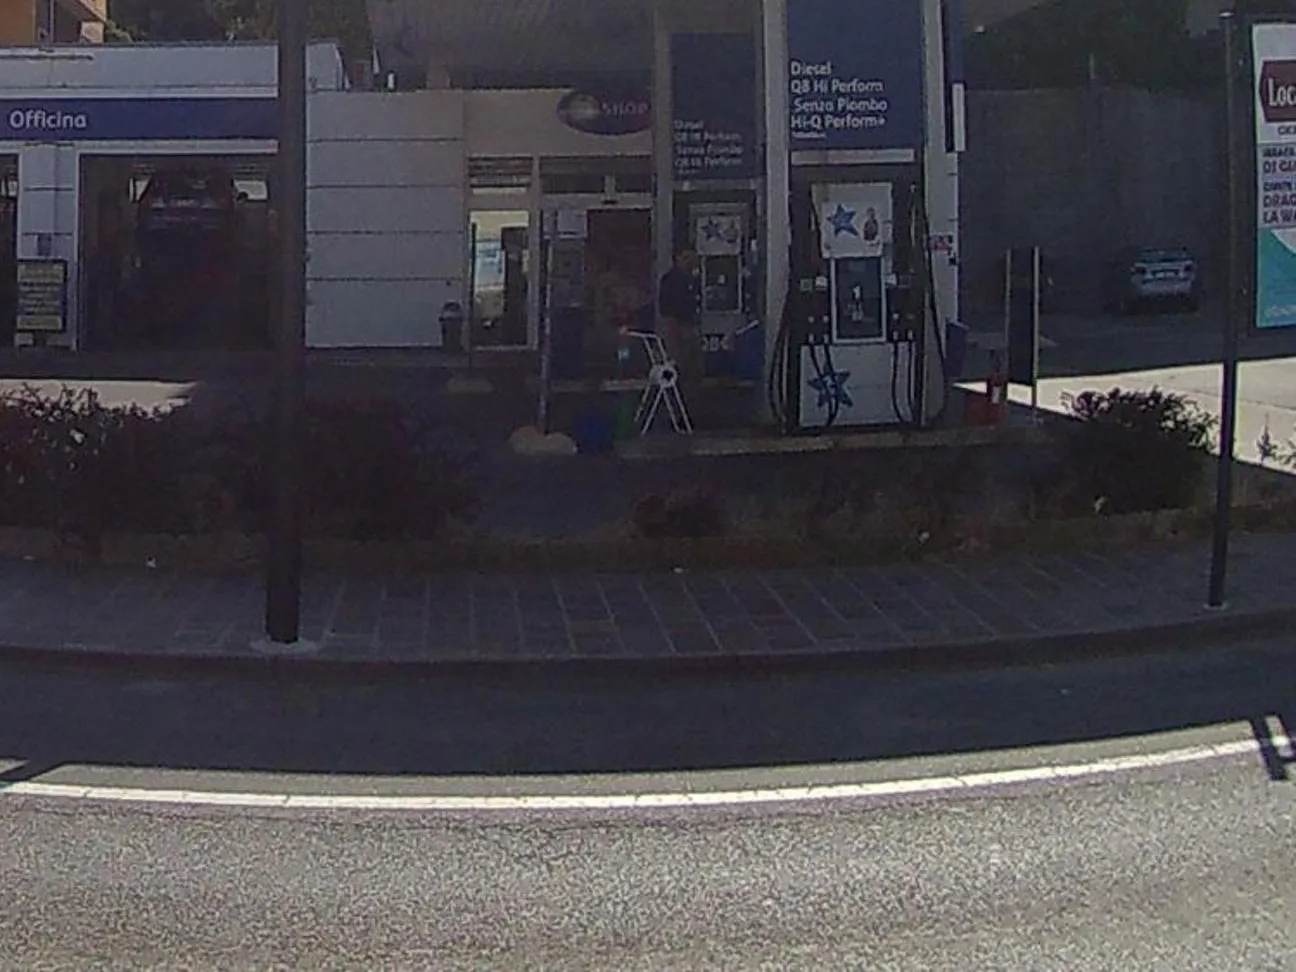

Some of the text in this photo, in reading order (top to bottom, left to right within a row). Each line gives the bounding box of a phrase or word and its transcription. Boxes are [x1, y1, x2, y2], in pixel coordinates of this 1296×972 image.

[790, 60, 832, 75] Diesel
[832, 78, 884, 93] Perform
[793, 97, 888, 112] Senza Piombo
[10, 110, 87, 129] Officina
